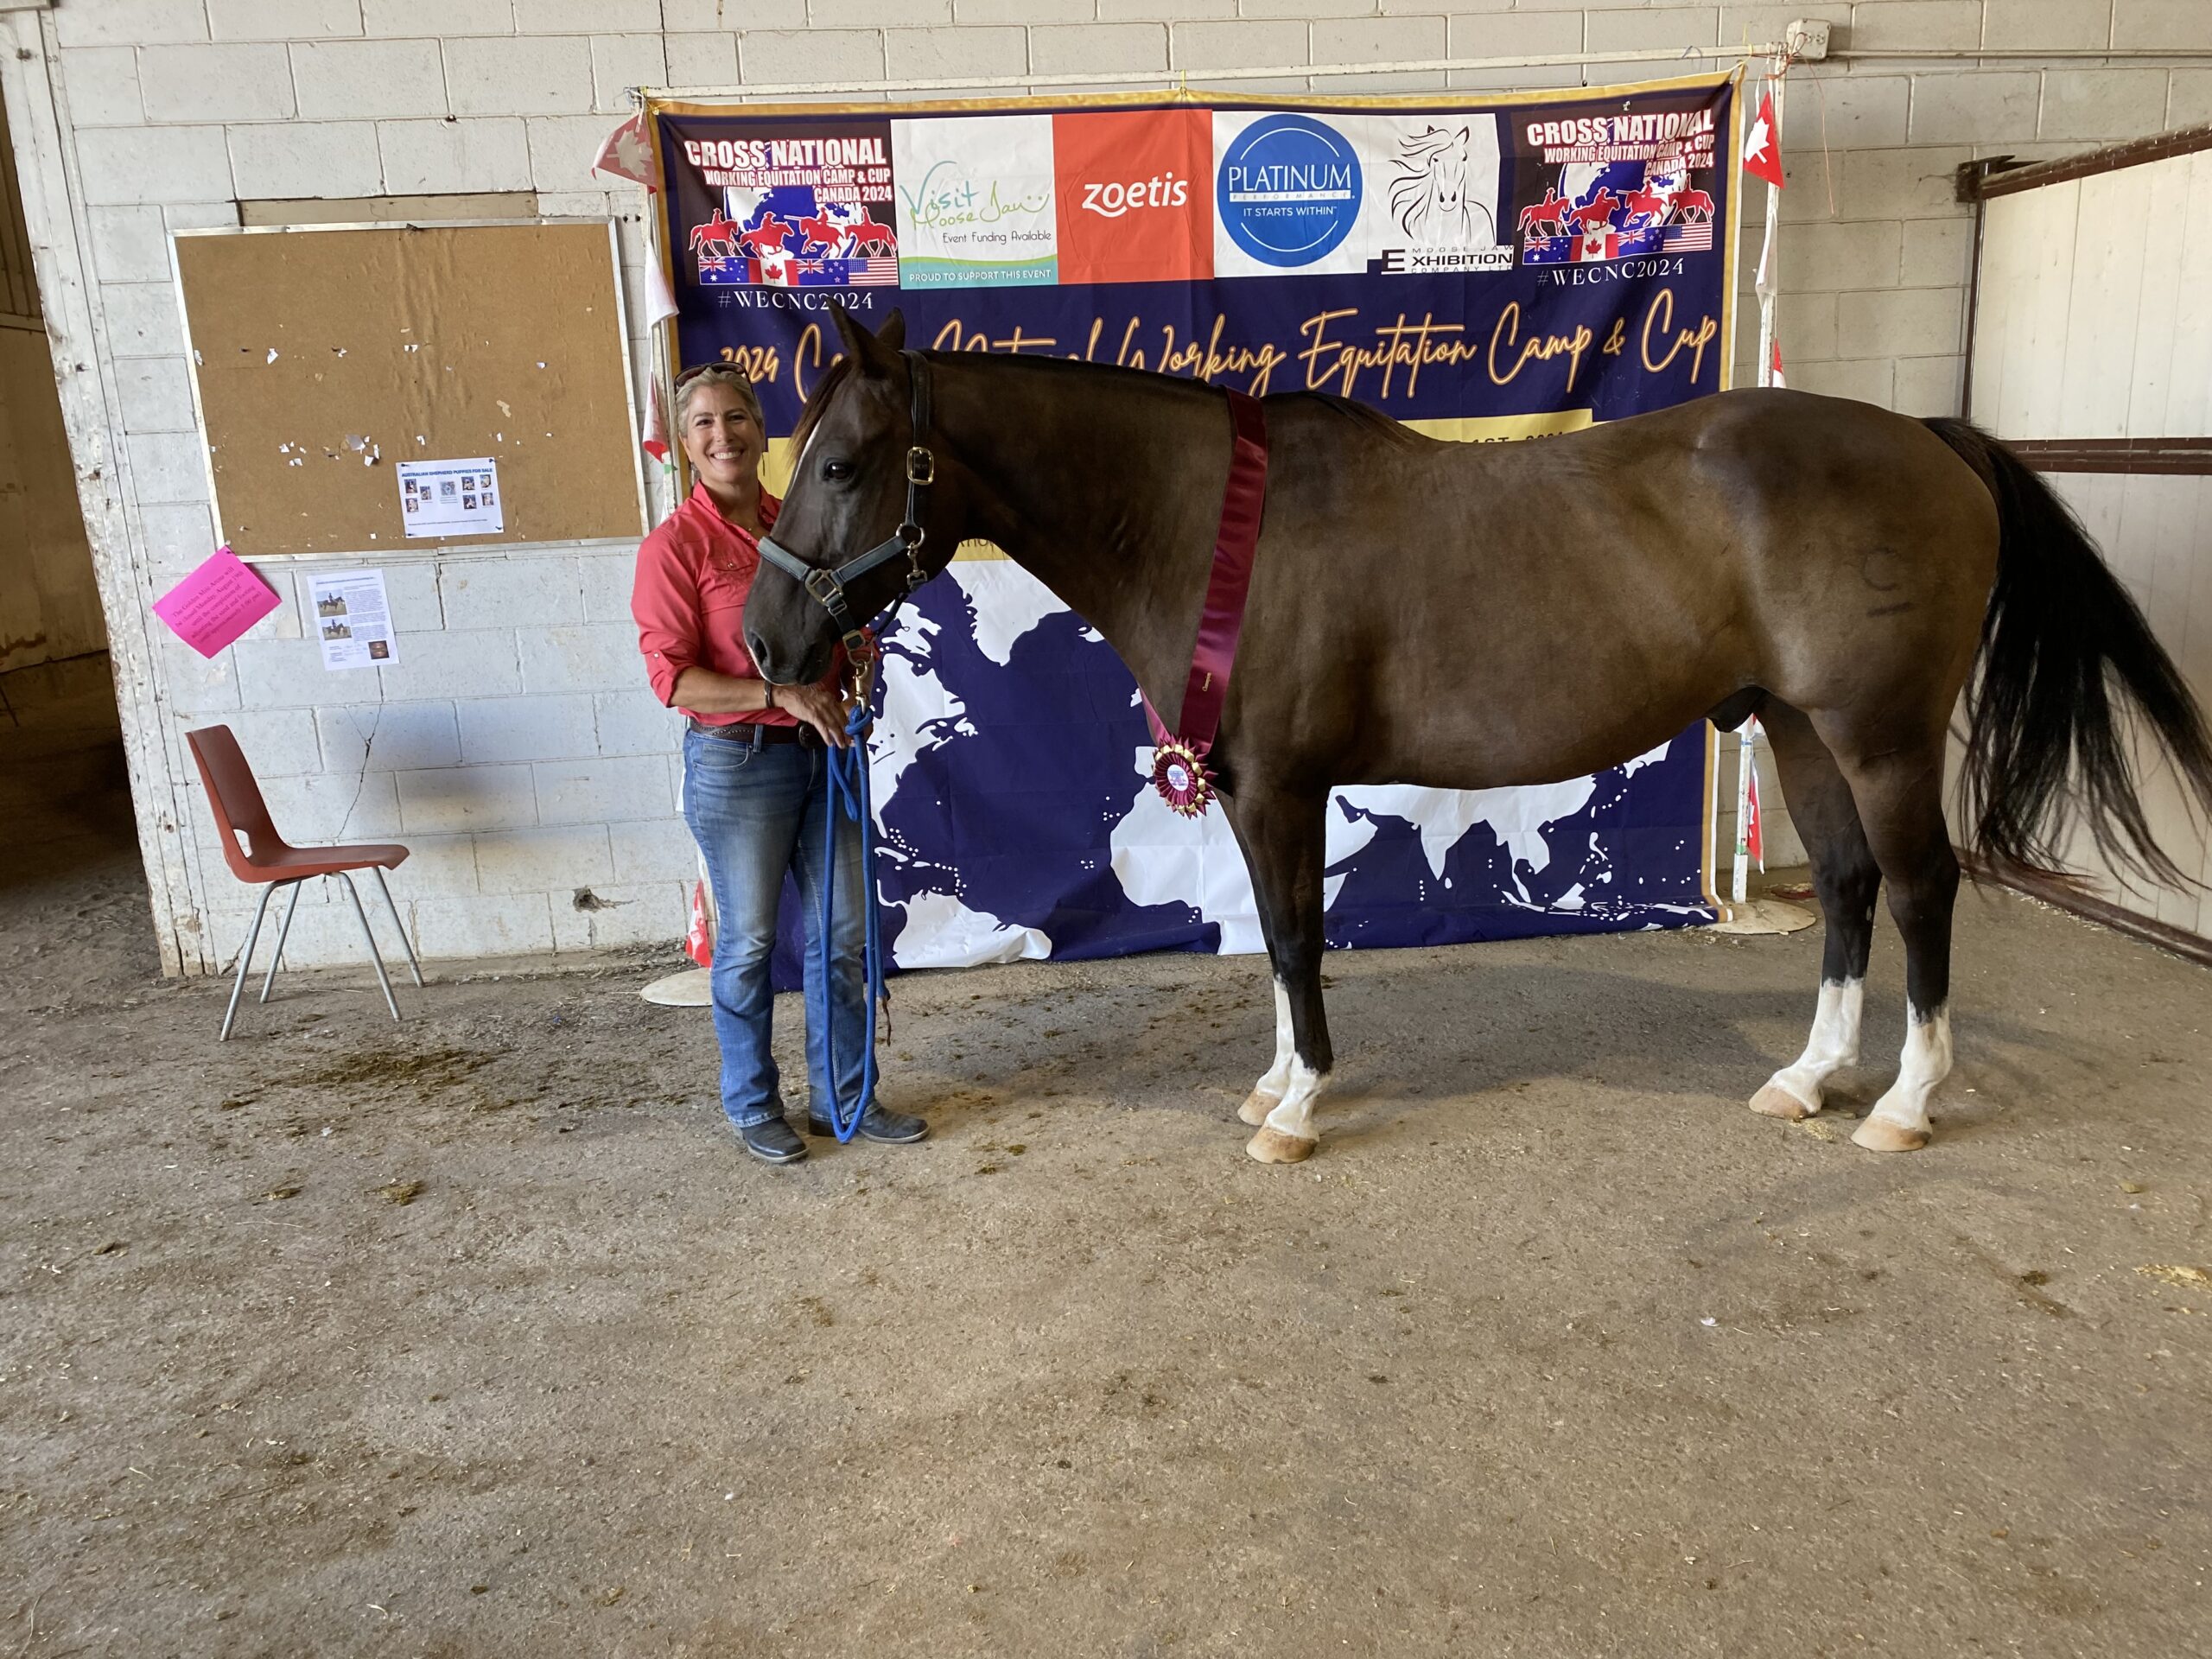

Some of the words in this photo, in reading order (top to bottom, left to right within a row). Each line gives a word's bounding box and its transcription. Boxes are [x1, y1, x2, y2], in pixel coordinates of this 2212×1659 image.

[1527, 119, 1608, 146] CROSS
[1613, 110, 1714, 143] NATIONAL
[683, 140, 767, 168] CROSS
[770, 138, 887, 167] NATIONAL
[1544, 147, 1596, 163] WORKING
[1597, 144, 1656, 162] EQUITATION
[1656, 142, 1682, 158] CAMP
[1684, 139, 1694, 153] &
[1694, 134, 1714, 150] CUP
[703, 170, 756, 187] WORKING
[758, 169, 821, 186] EQUITATION
[823, 168, 855, 185] CAMP
[857, 169, 866, 184] &
[868, 168, 891, 183] CUP
[1228, 163, 1351, 191] PLATINUM
[1644, 157, 1687, 176] CANADA
[1688, 152, 1713, 169] 2024
[814, 188, 861, 203] CANADA
[863, 186, 893, 201] 2024
[899, 161, 980, 214] Visit
[1081, 171, 1188, 218] zoetis
[910, 201, 979, 230] Moose
[980, 180, 1050, 223] Jaw
[1243, 207, 1253, 217] IT
[1255, 207, 1294, 217] STARTS
[943, 232, 967, 243] Event
[972, 232, 1007, 245] Funding
[1011, 230, 1052, 242] Available
[909, 273, 941, 282] PROUD
[944, 272, 957, 281] TO
[958, 271, 999, 281] SUPPORT
[1001, 270, 1020, 279] THIS
[1022, 270, 1052, 278] EVENT
[1536, 257, 1684, 287] #WECNC2024
[717, 290, 874, 309] #WECNC2024
[1298, 308, 1478, 399] Equitation
[1488, 300, 1593, 394] Camp
[1602, 316, 1626, 356] &
[1642, 288, 1718, 385] Cup
